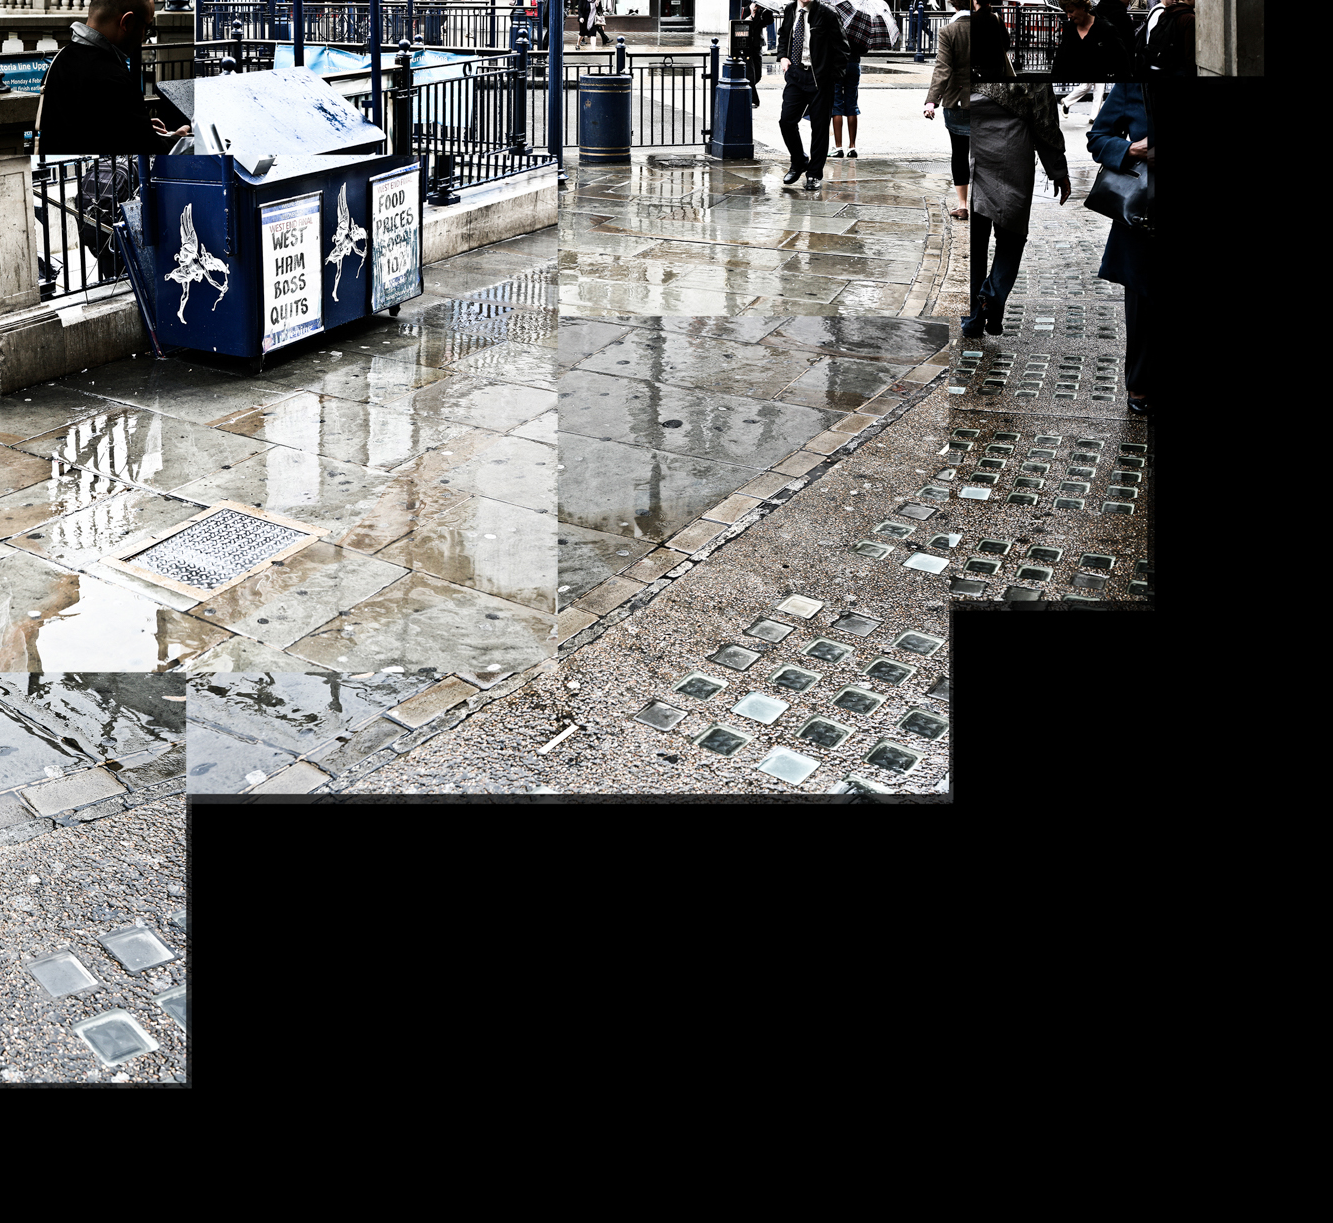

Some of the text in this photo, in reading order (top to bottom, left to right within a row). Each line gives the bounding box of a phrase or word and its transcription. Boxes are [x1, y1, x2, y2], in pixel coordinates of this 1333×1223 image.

[734, 30, 750, 38] WAIT
[17, 61, 31, 70] line
[10, 78, 28, 86] Monday
[376, 175, 413, 194] WEST END FINAL
[378, 189, 406, 214] FOOD
[269, 216, 314, 234] WEST END FINAL
[376, 207, 414, 235] PRICES
[271, 226, 308, 251] WEST
[274, 252, 306, 277] HAM
[274, 273, 307, 300] BOSS
[270, 298, 309, 326] QUITS
